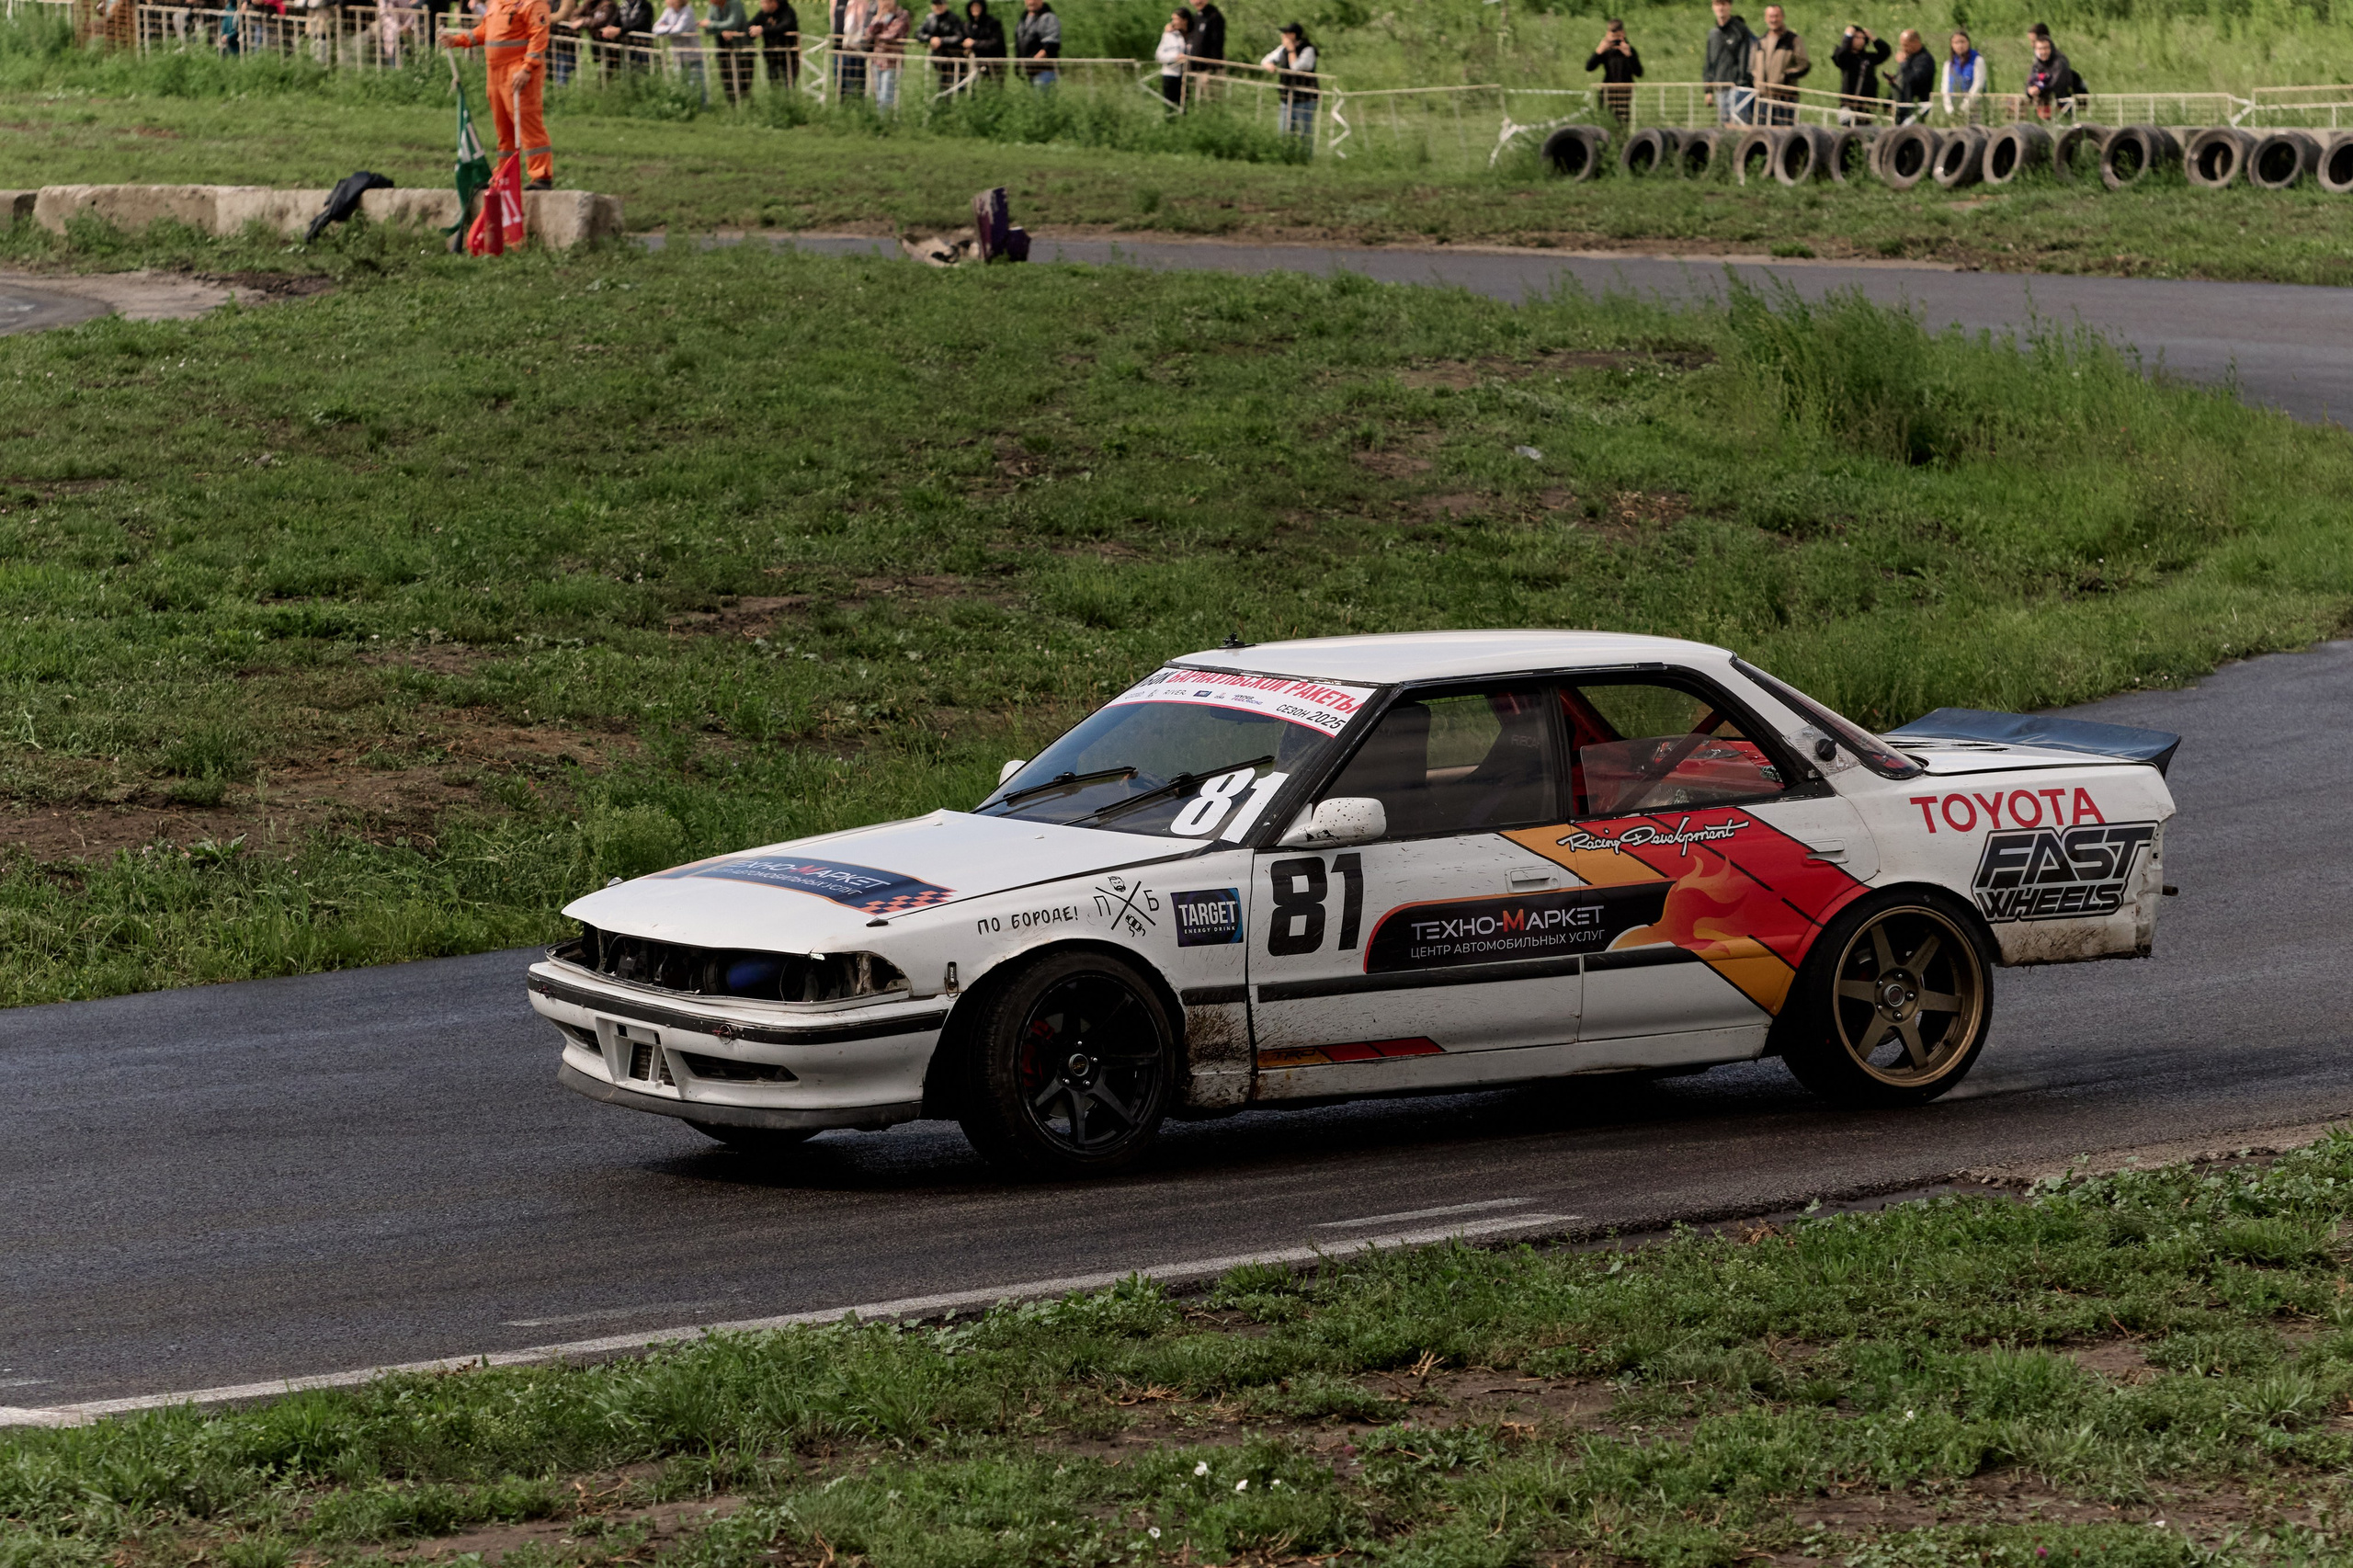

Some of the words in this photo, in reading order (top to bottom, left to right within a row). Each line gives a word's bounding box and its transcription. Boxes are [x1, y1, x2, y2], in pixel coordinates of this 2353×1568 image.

[1283, 681, 1365, 714] РАКЕТЫ
[1276, 704, 1311, 719] СЕЗОН
[1306, 711, 1347, 729] 2025
[1170, 767, 1290, 844] 81
[1910, 788, 2106, 834] TOYOTA
[1557, 827, 1621, 854] Racing
[1178, 900, 1237, 926] TARGET
[1267, 853, 1363, 957] 81
[1976, 882, 2124, 918] WHEELS
[977, 917, 1001, 935] ПО
[1011, 906, 1079, 930] БОРОДЕ!
[1184, 926, 1212, 935] ENERGY
[1213, 926, 1236, 934] DRINK
[1411, 905, 1605, 940] ТЕХНО-МАРКЕТ
[1411, 945, 1451, 959] ЦЕНТР
[1453, 934, 1566, 954] АВТОМОБИЛЬНЫХ
[1568, 929, 1606, 944] УСЛУГ
